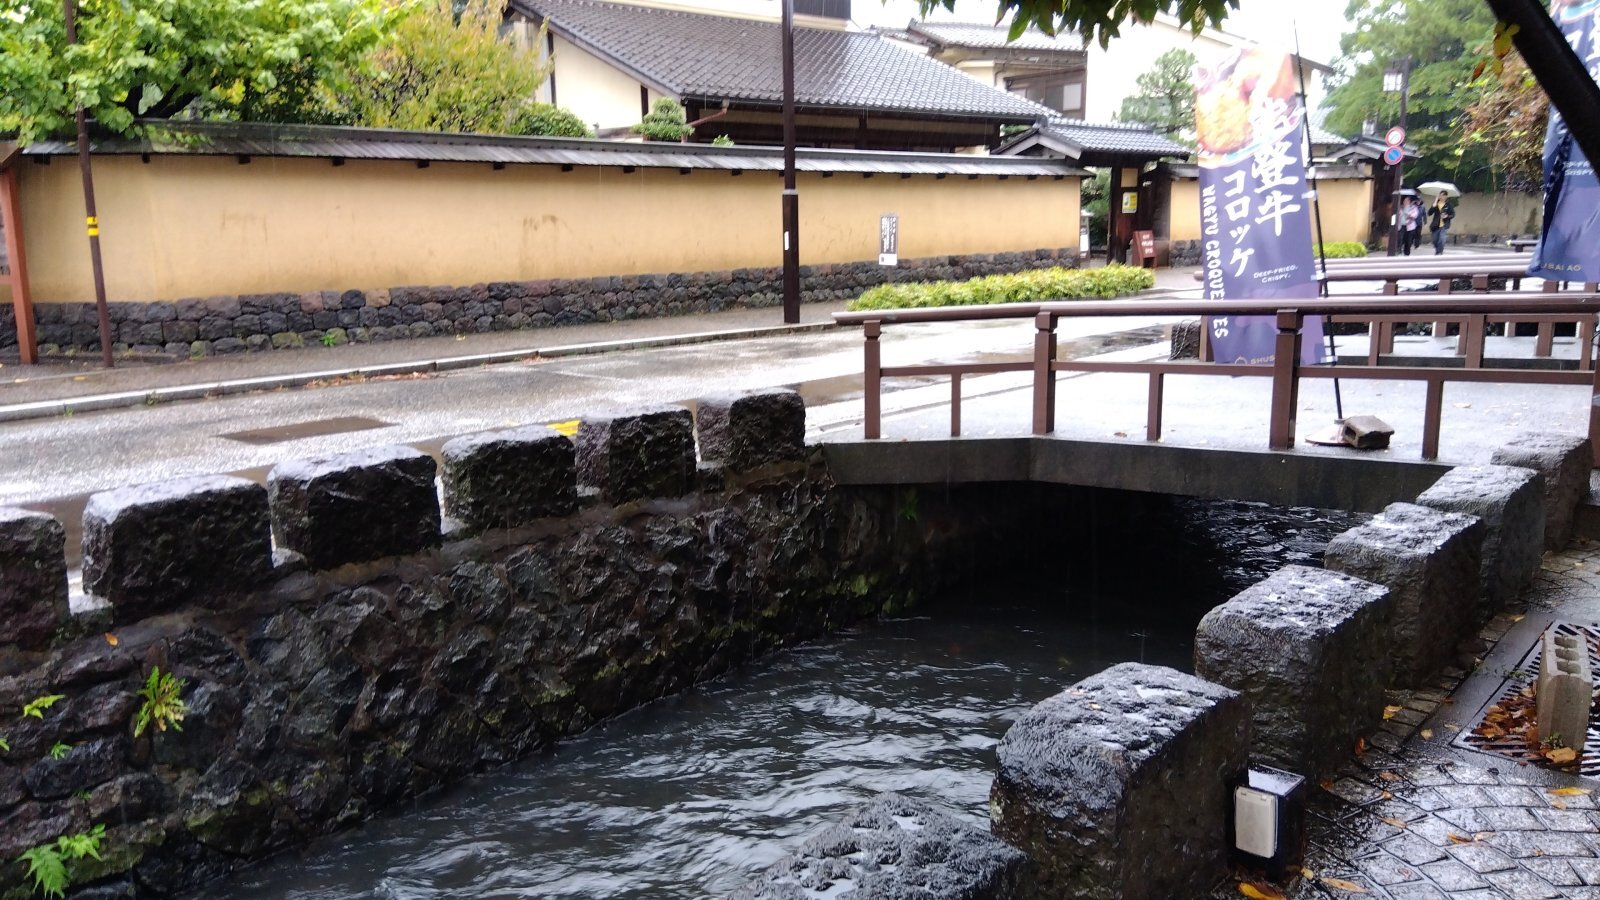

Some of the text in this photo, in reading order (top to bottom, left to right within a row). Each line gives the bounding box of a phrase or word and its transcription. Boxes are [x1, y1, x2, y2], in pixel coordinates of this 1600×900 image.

[1202, 184, 1229, 339] WAGYU CROQUEES
[1222, 169, 1255, 278] コロッケ
